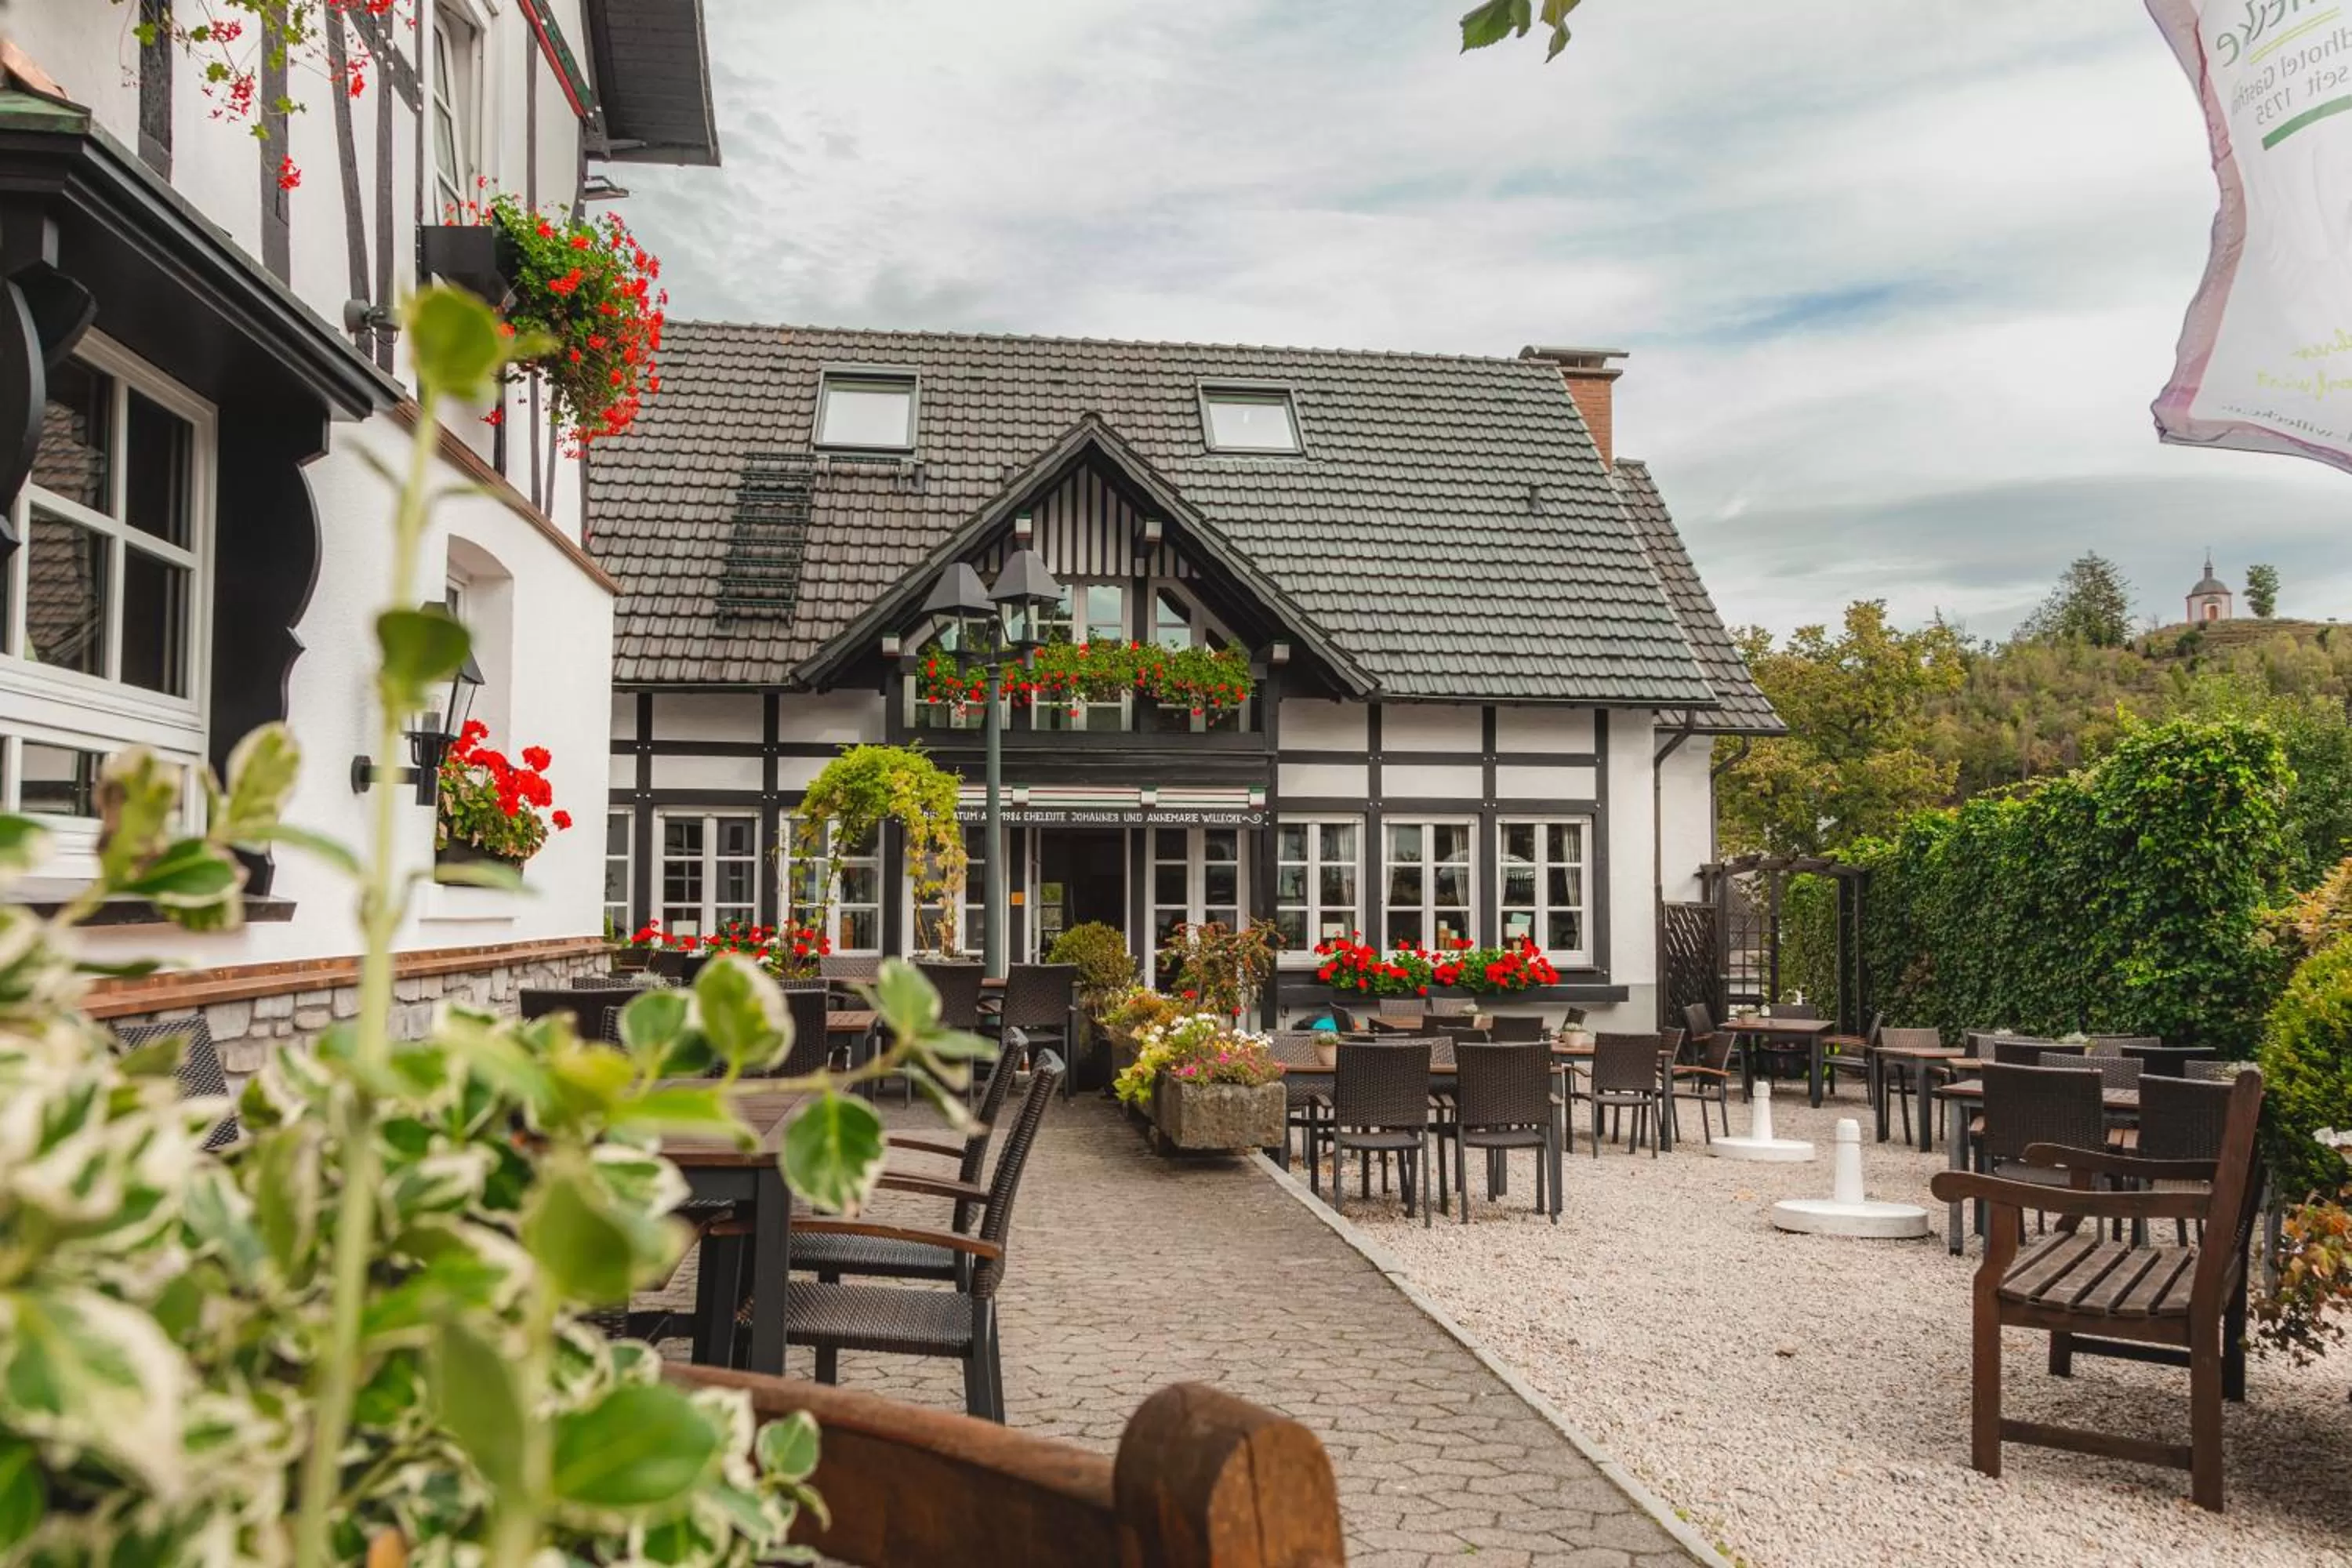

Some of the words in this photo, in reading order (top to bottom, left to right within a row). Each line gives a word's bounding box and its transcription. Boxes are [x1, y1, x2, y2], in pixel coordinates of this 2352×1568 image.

[1071, 811, 1120, 822] JOHANNES
[1123, 812, 1143, 822] UND
[1146, 813, 1199, 822] ANNEMARIE
[1201, 813, 1242, 823] WILLECKE
